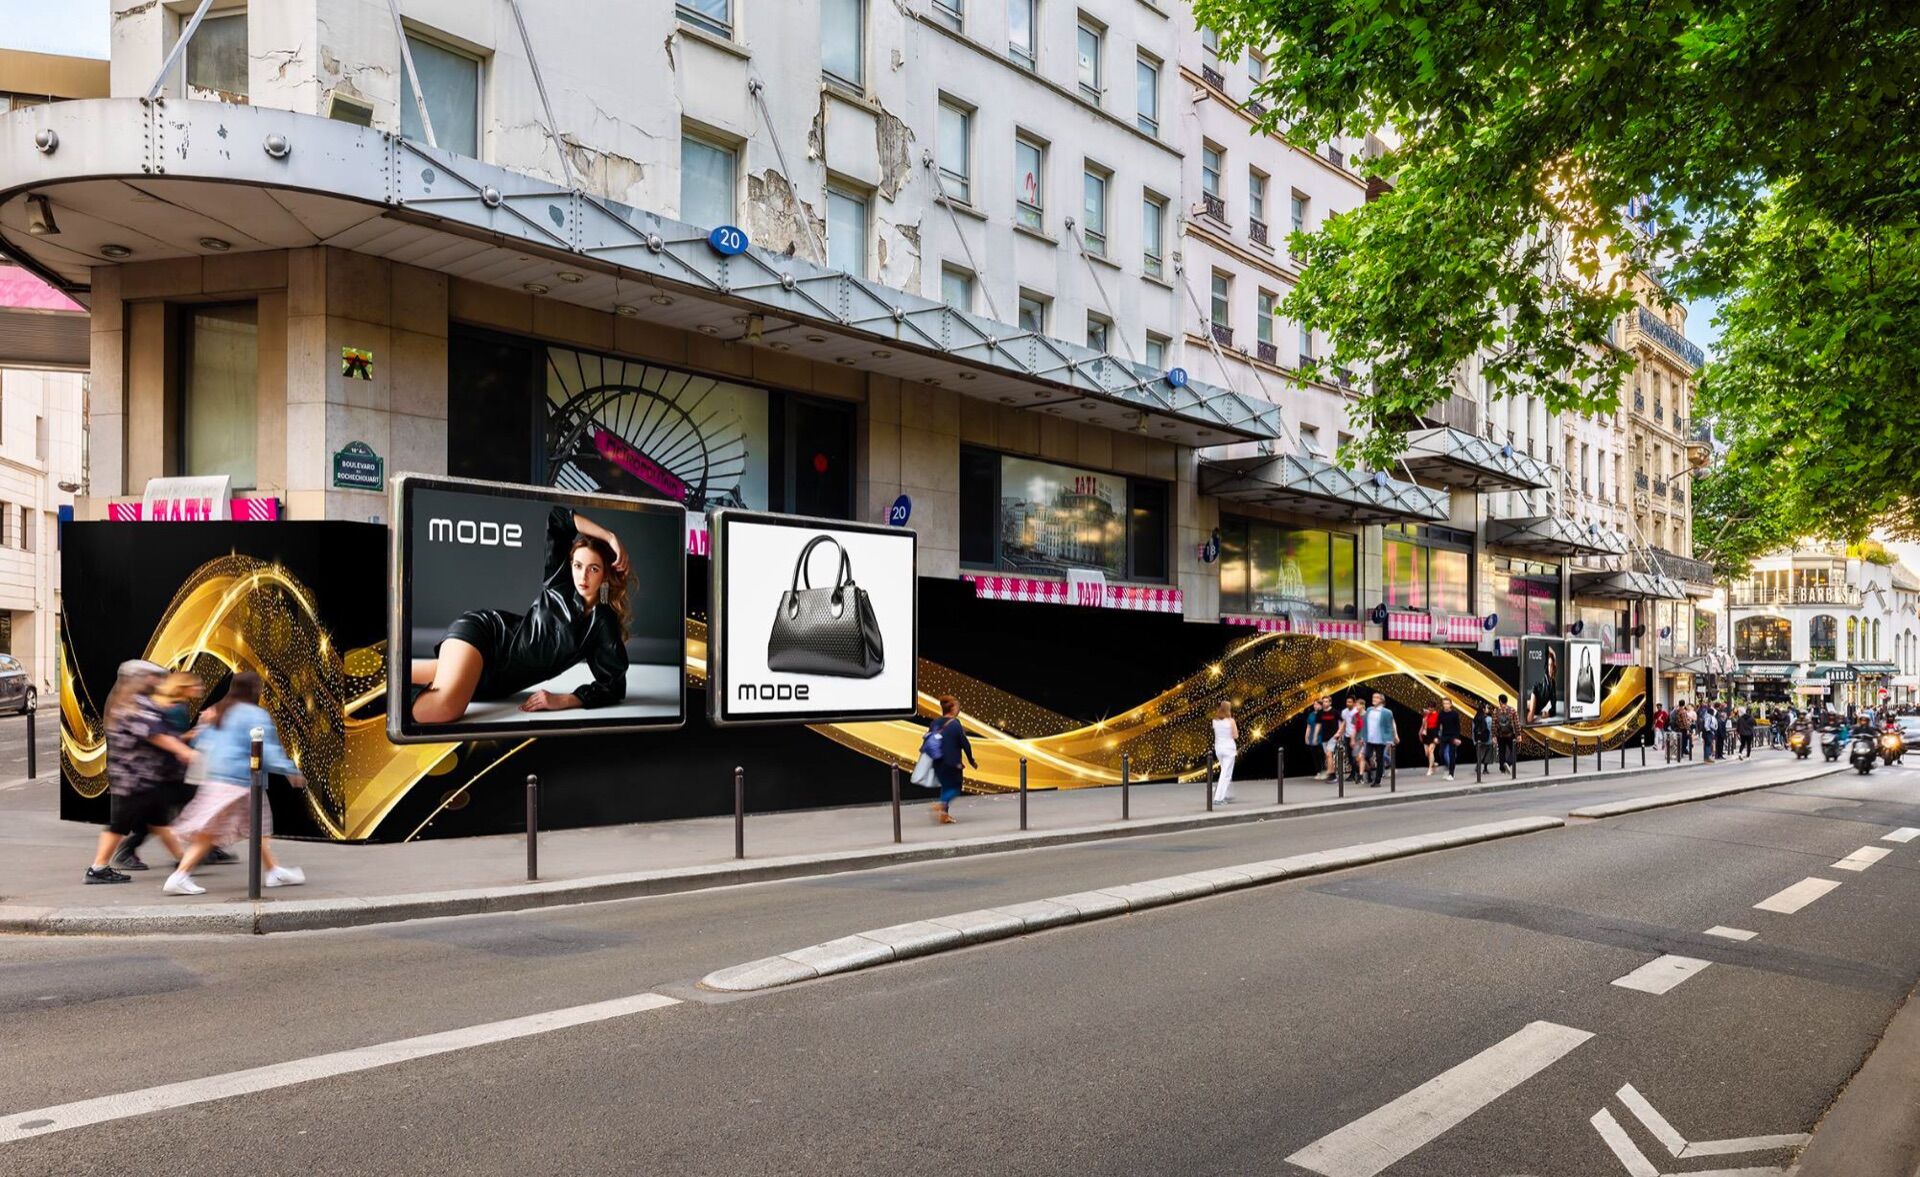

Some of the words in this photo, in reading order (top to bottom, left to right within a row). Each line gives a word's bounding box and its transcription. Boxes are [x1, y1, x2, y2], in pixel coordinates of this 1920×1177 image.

[720, 229, 740, 249] 20
[1174, 370, 1184, 383] 18
[342, 460, 376, 471] BOULEVARD
[892, 506, 906, 520] 20
[1206, 545, 1216, 555] 18
[1077, 582, 1103, 606] TATI
[1375, 609, 1385, 618] 10
